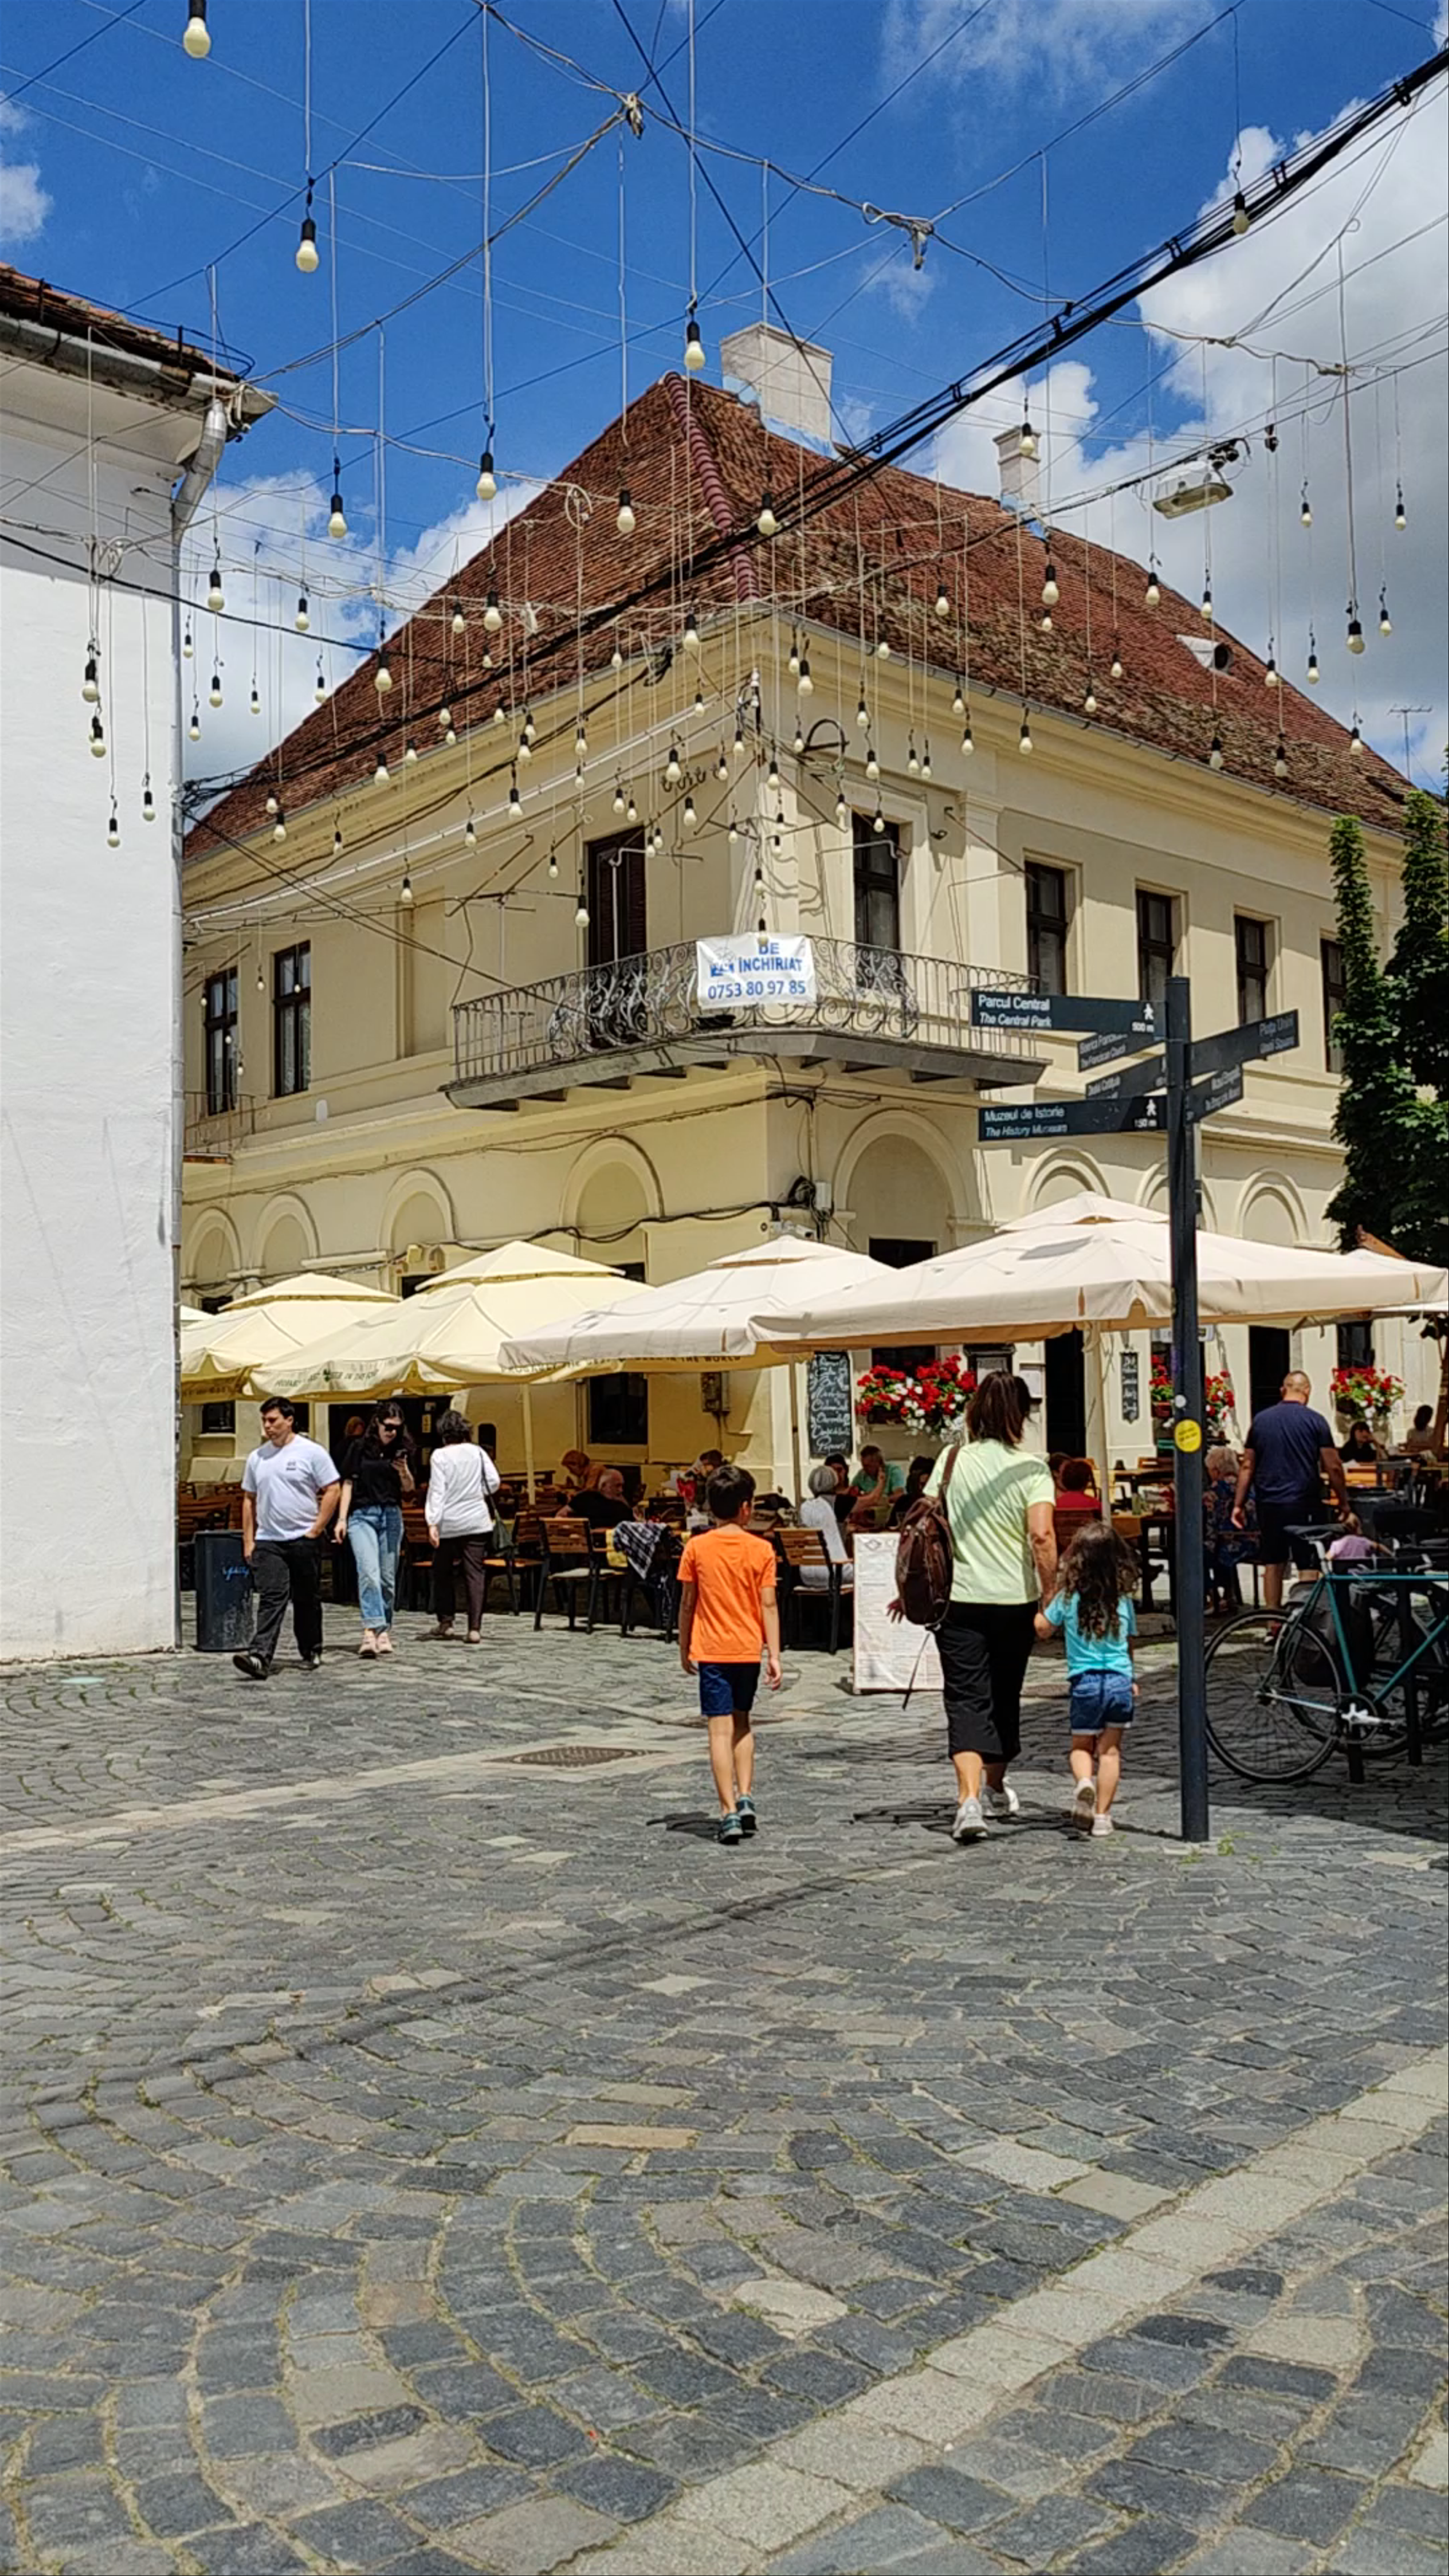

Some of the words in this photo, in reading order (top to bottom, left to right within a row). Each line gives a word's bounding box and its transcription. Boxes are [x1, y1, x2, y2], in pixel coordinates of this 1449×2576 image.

[758, 942, 780, 955] DE
[708, 983, 742, 1000] 0753
[746, 981, 764, 995] 80
[767, 980, 784, 995] 97
[789, 980, 806, 995] 85
[978, 995, 1011, 1009] Parcul
[1013, 996, 1050, 1011] Central
[980, 1012, 996, 1024] The
[998, 1014, 1030, 1026] Central
[1031, 1015, 1052, 1028] Park
[984, 1109, 1018, 1122] Muzeul
[1020, 1108, 1032, 1120] de
[1035, 1106, 1064, 1118] Istorie
[985, 1127, 1000, 1137] The
[1001, 1125, 1030, 1137] History
